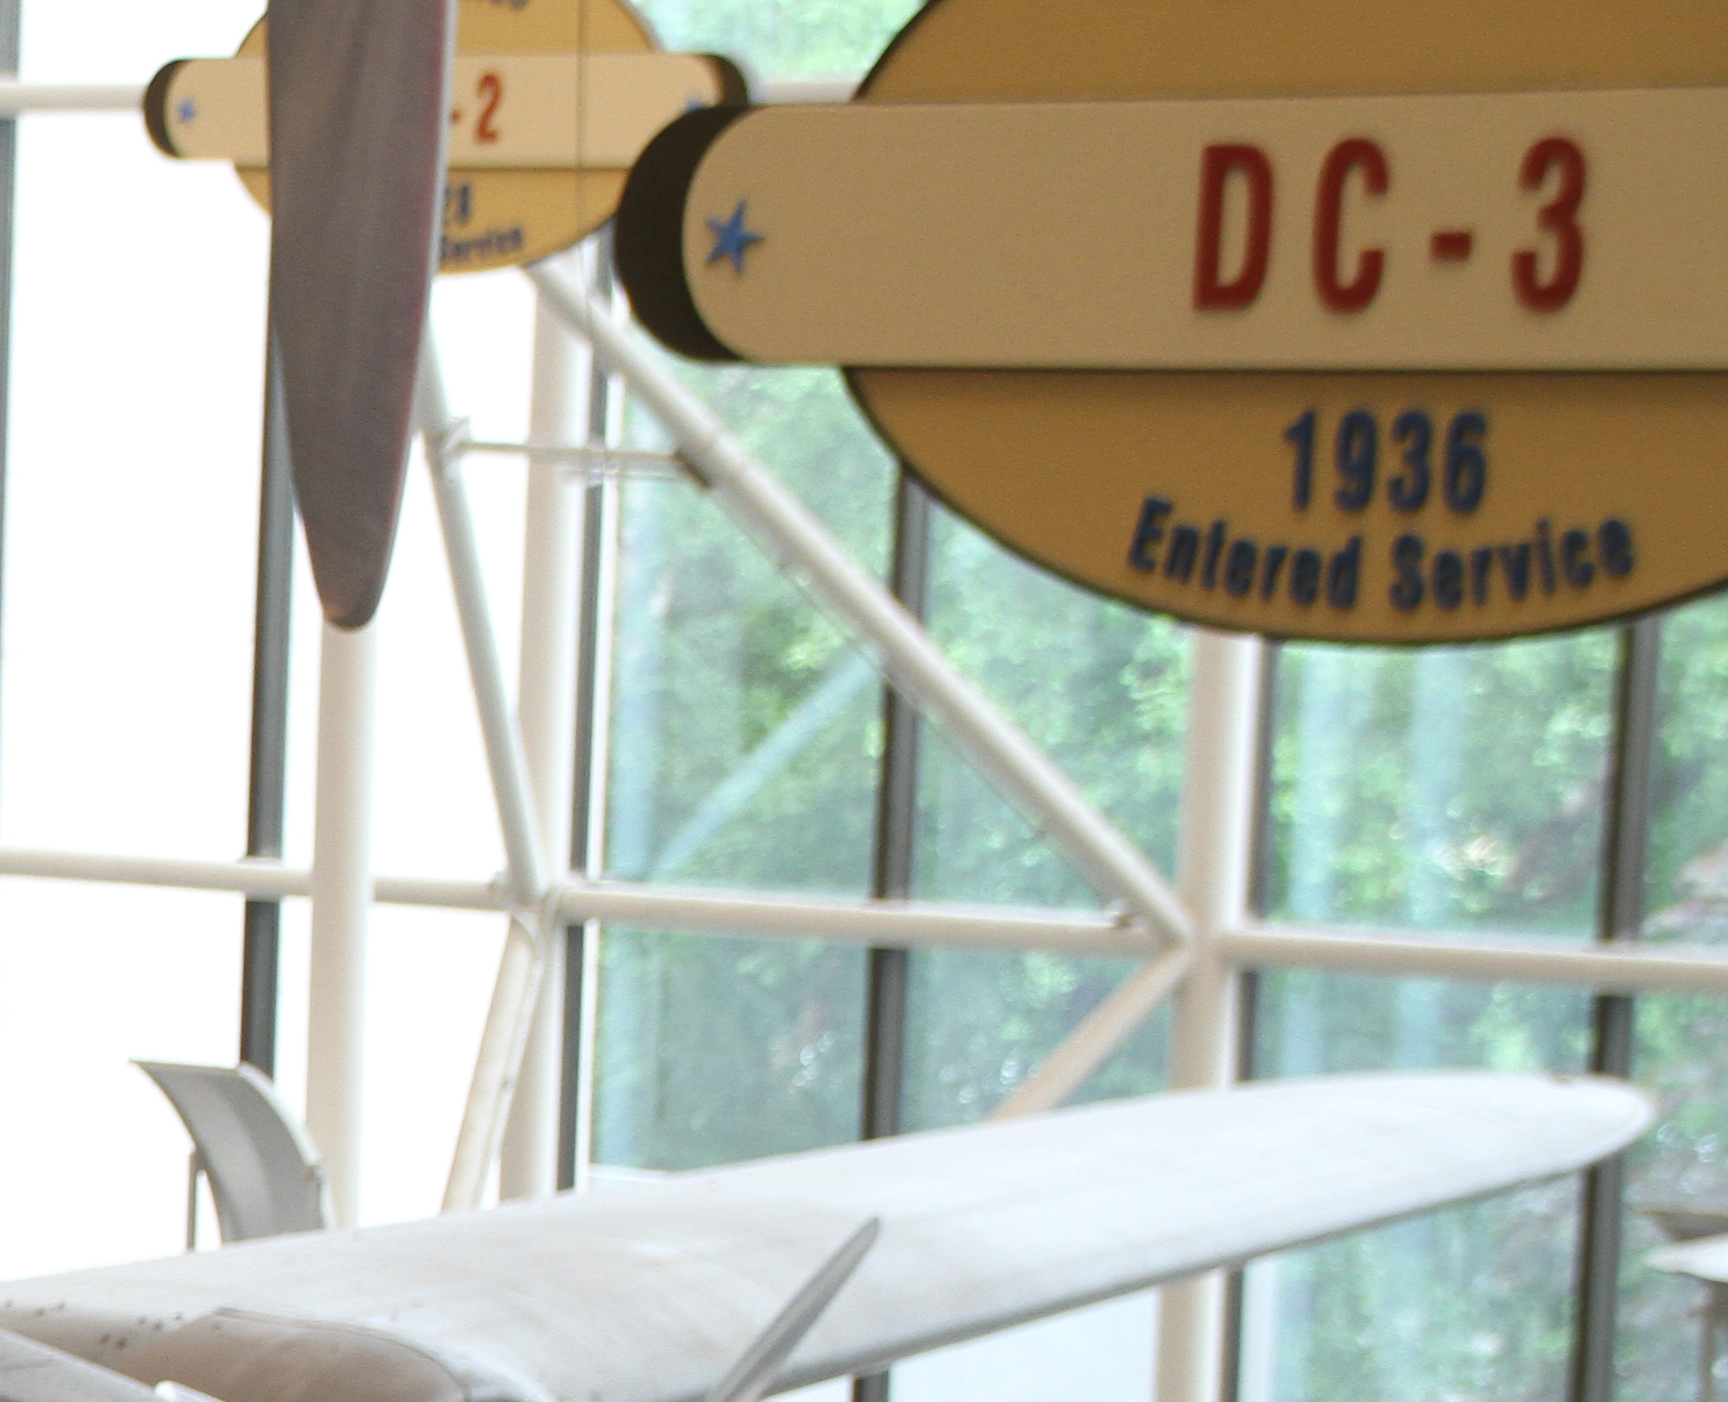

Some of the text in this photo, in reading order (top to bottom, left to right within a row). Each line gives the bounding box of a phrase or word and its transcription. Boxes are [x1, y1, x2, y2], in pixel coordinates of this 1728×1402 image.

[450, 71, 503, 145] -2
[1190, 136, 1589, 313] DC-3
[1282, 408, 1489, 514] 1936
[1127, 495, 1635, 612] Entered Service
